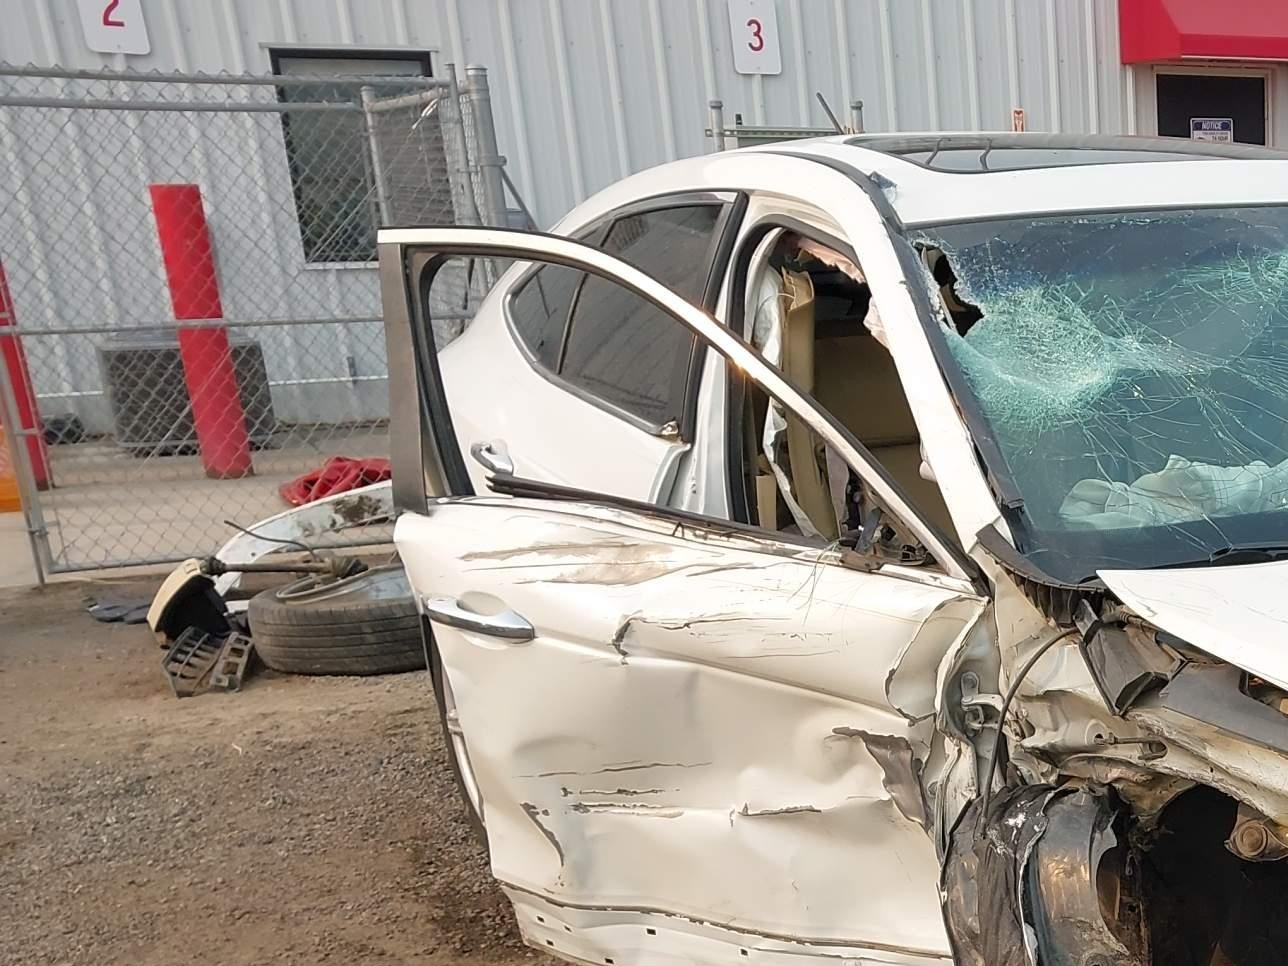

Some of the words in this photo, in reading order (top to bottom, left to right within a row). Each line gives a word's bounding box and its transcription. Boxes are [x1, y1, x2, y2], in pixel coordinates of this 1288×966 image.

[102, 0, 125, 27] 2
[747, 19, 765, 52] 3
[1202, 121, 1221, 130] NOTICE
